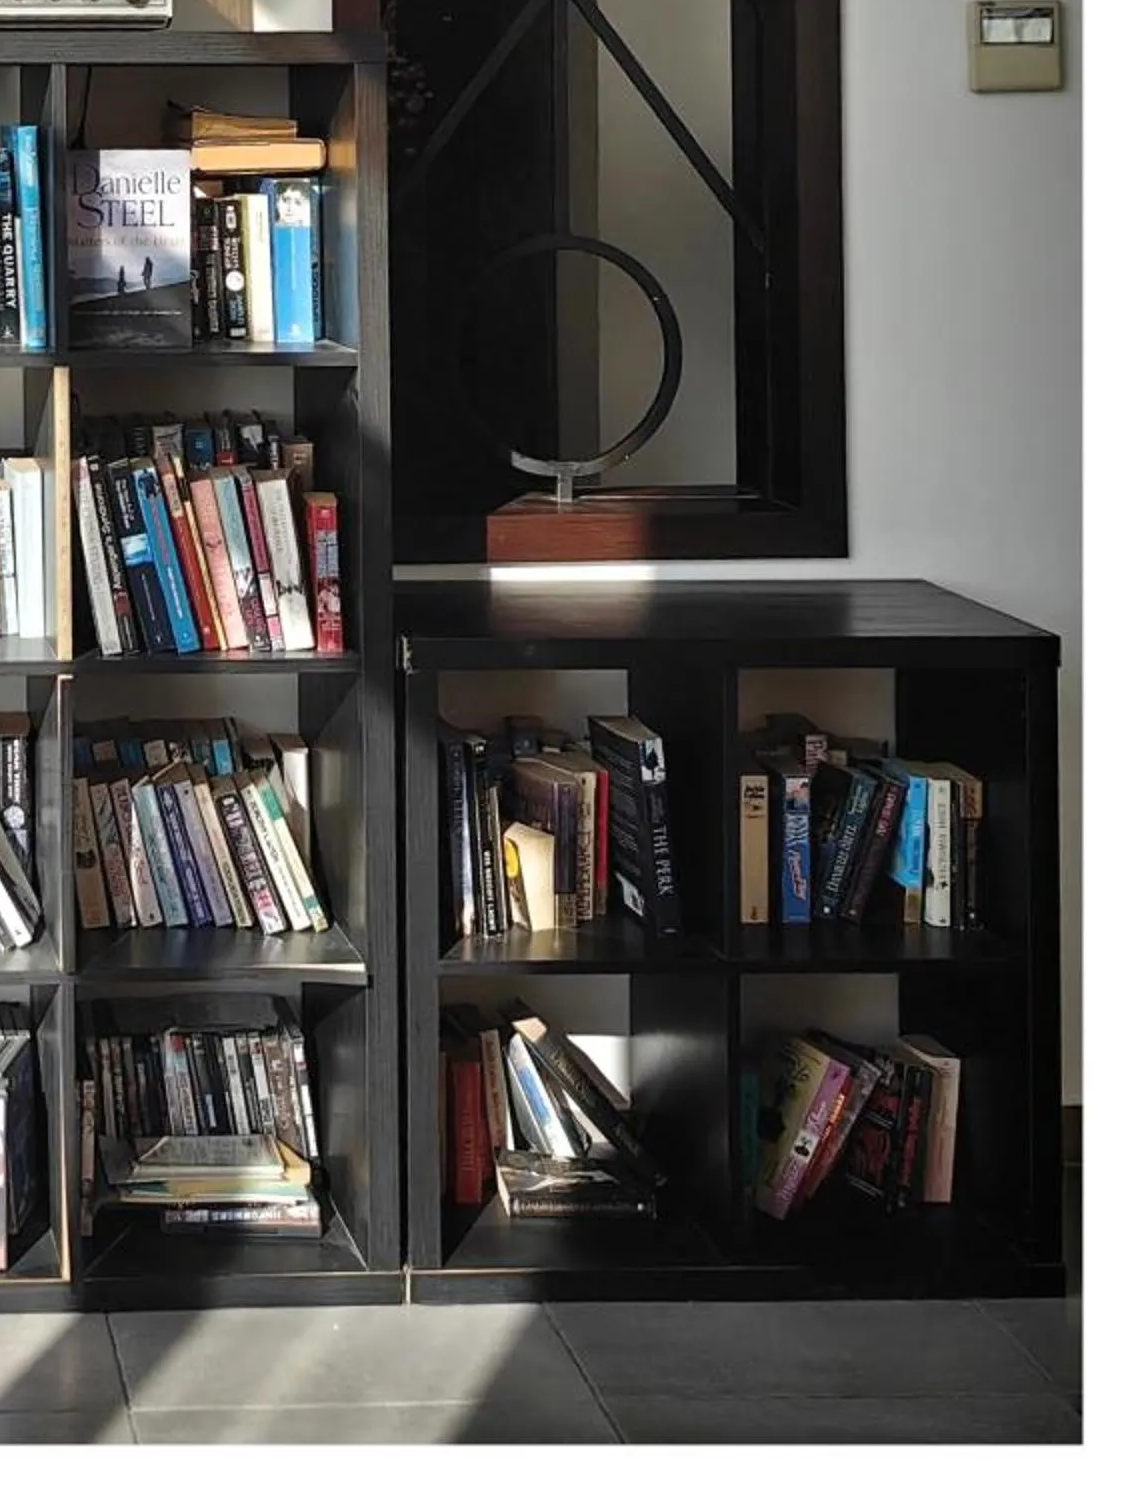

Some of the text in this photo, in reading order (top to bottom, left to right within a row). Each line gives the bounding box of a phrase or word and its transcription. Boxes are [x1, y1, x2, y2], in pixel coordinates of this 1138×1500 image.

[72, 161, 181, 195] Danielle
[0, 213, 13, 241] THE
[2, 244, 17, 309] QUARRY
[652, 824, 669, 857] THE
